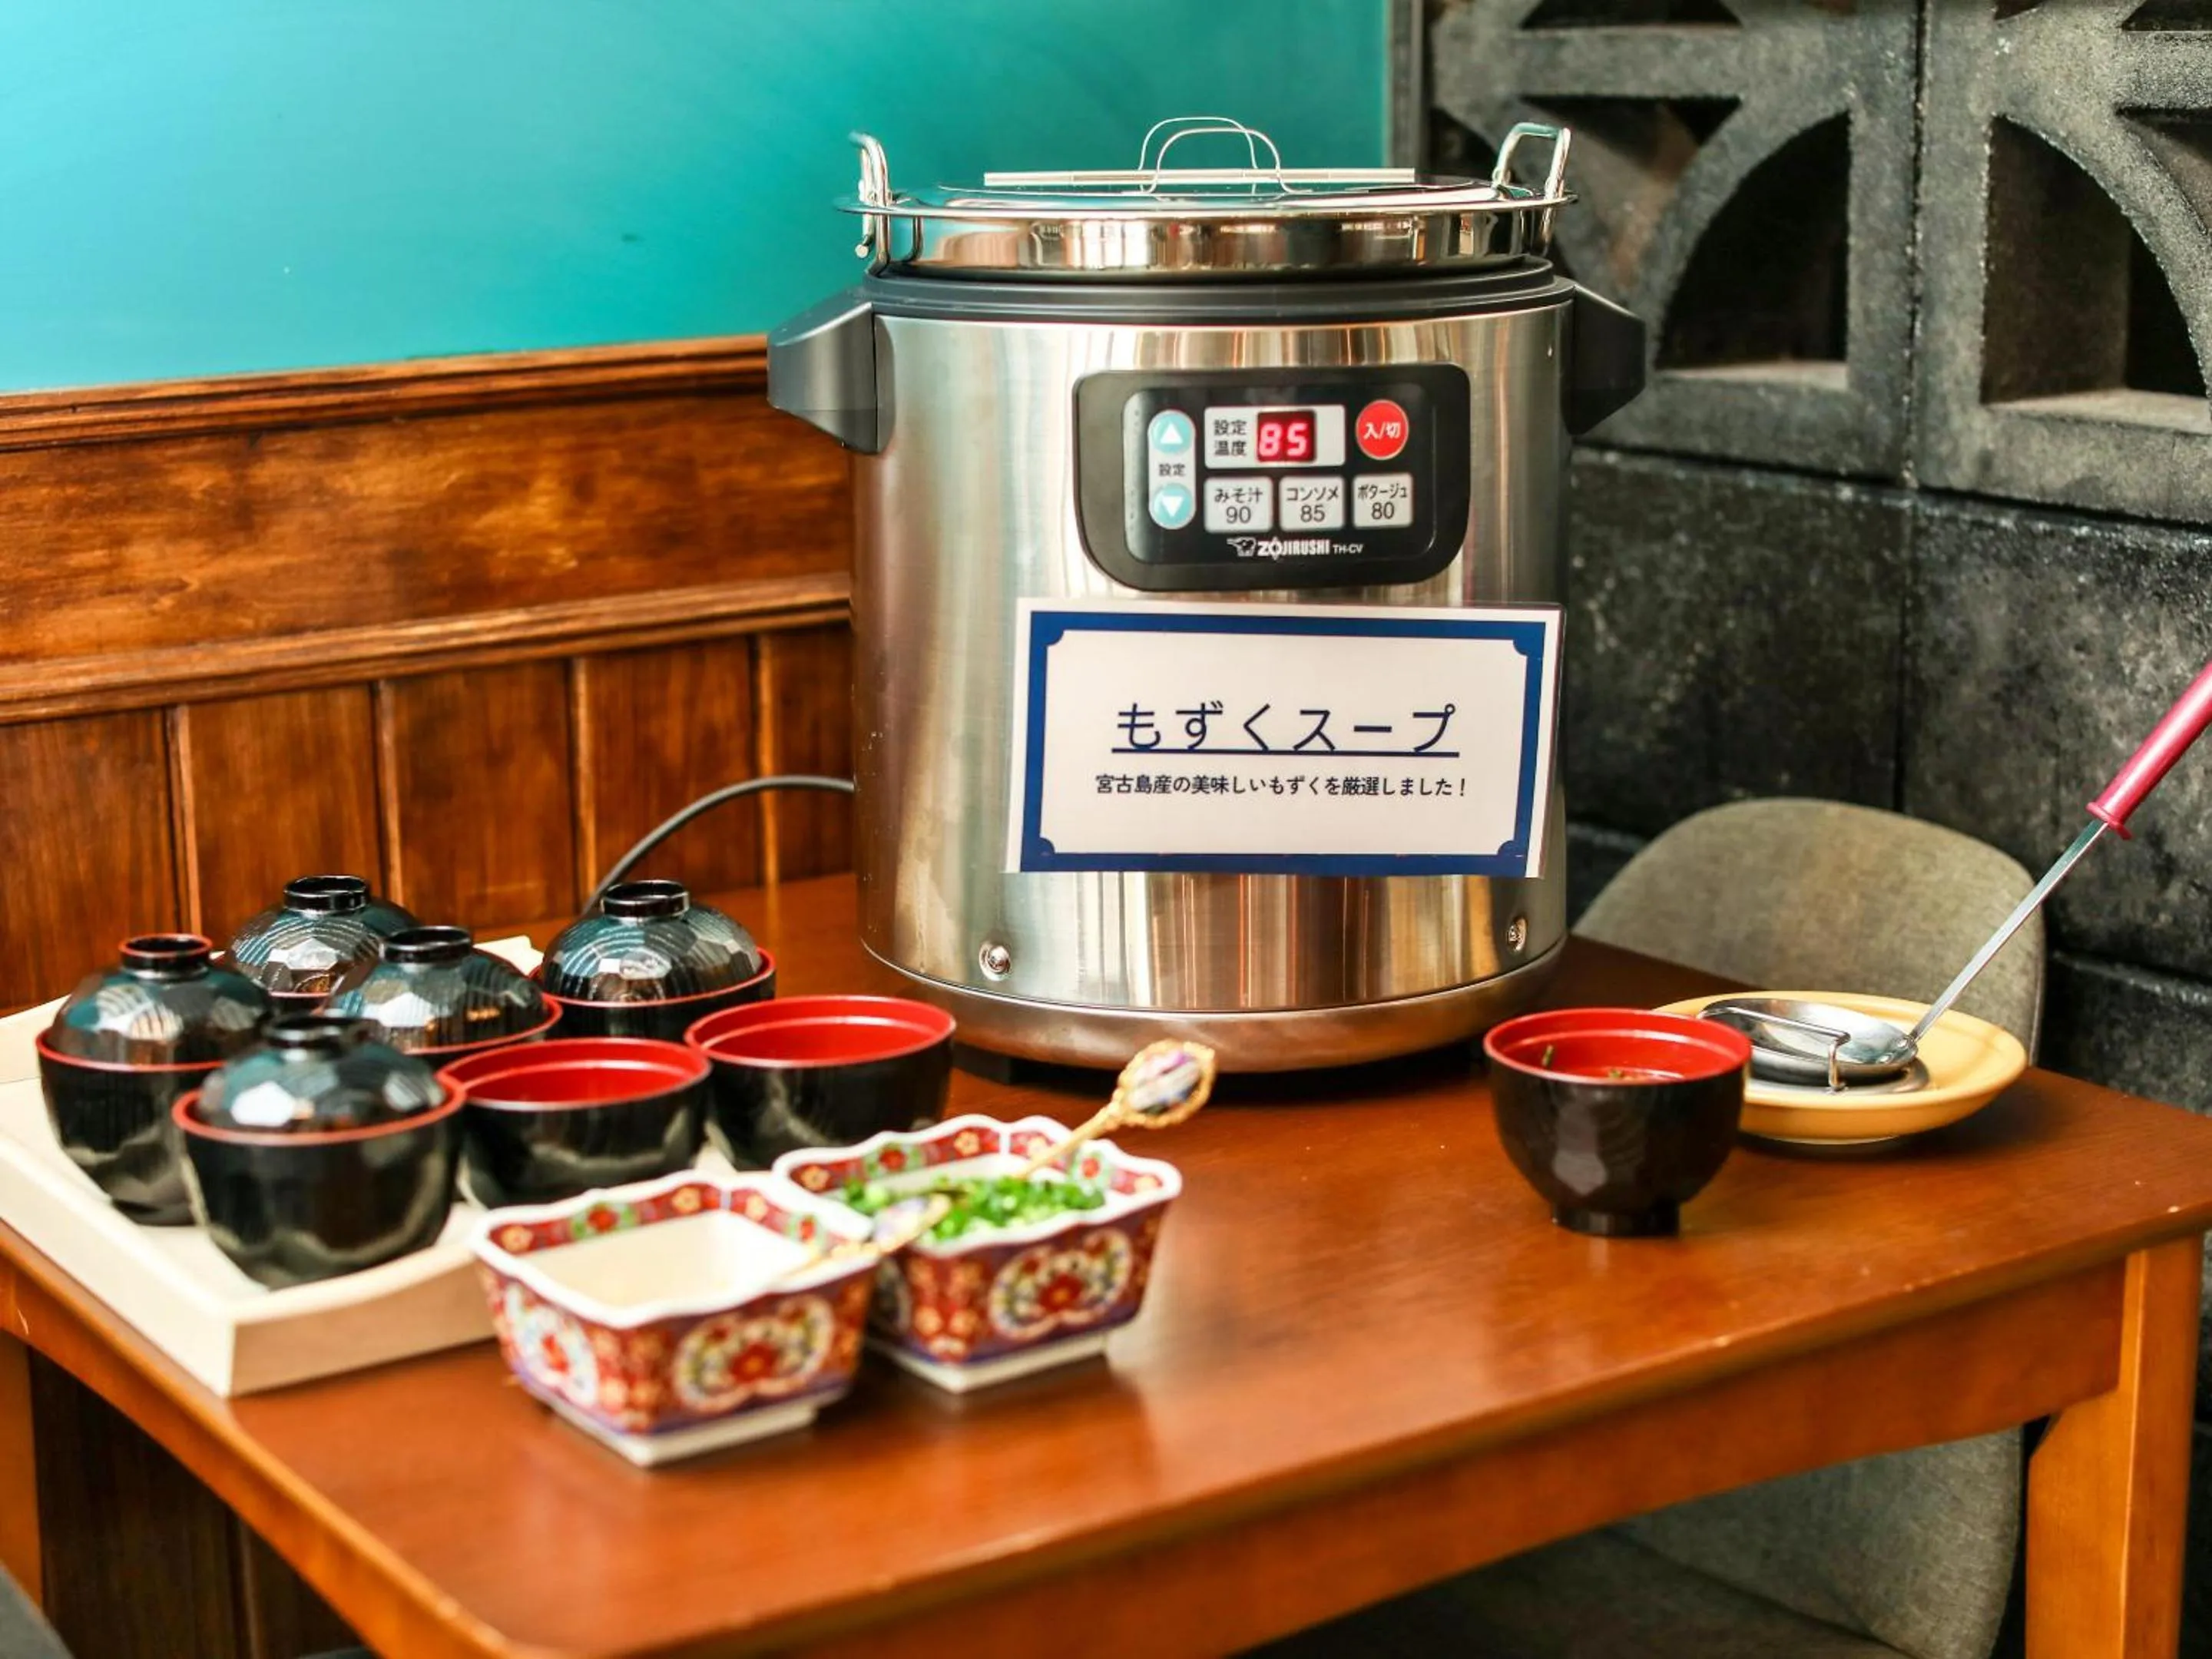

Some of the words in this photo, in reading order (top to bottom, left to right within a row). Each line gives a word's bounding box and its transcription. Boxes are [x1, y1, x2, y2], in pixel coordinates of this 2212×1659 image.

[1214, 419, 1247, 435] 設定
[1214, 440, 1247, 456] 温度
[1258, 422, 1309, 457] 85
[1158, 463, 1186, 477] 設定
[1214, 487, 1263, 503] みそ汁
[1286, 485, 1339, 502] コンソメ
[1225, 505, 1252, 524] 90
[1300, 505, 1326, 522] 85
[1371, 502, 1395, 520] 80
[1257, 537, 1330, 561] ZOJIRUSHI
[1333, 544, 1364, 555] TH-CV
[1116, 700, 1455, 754] もずくスープ
